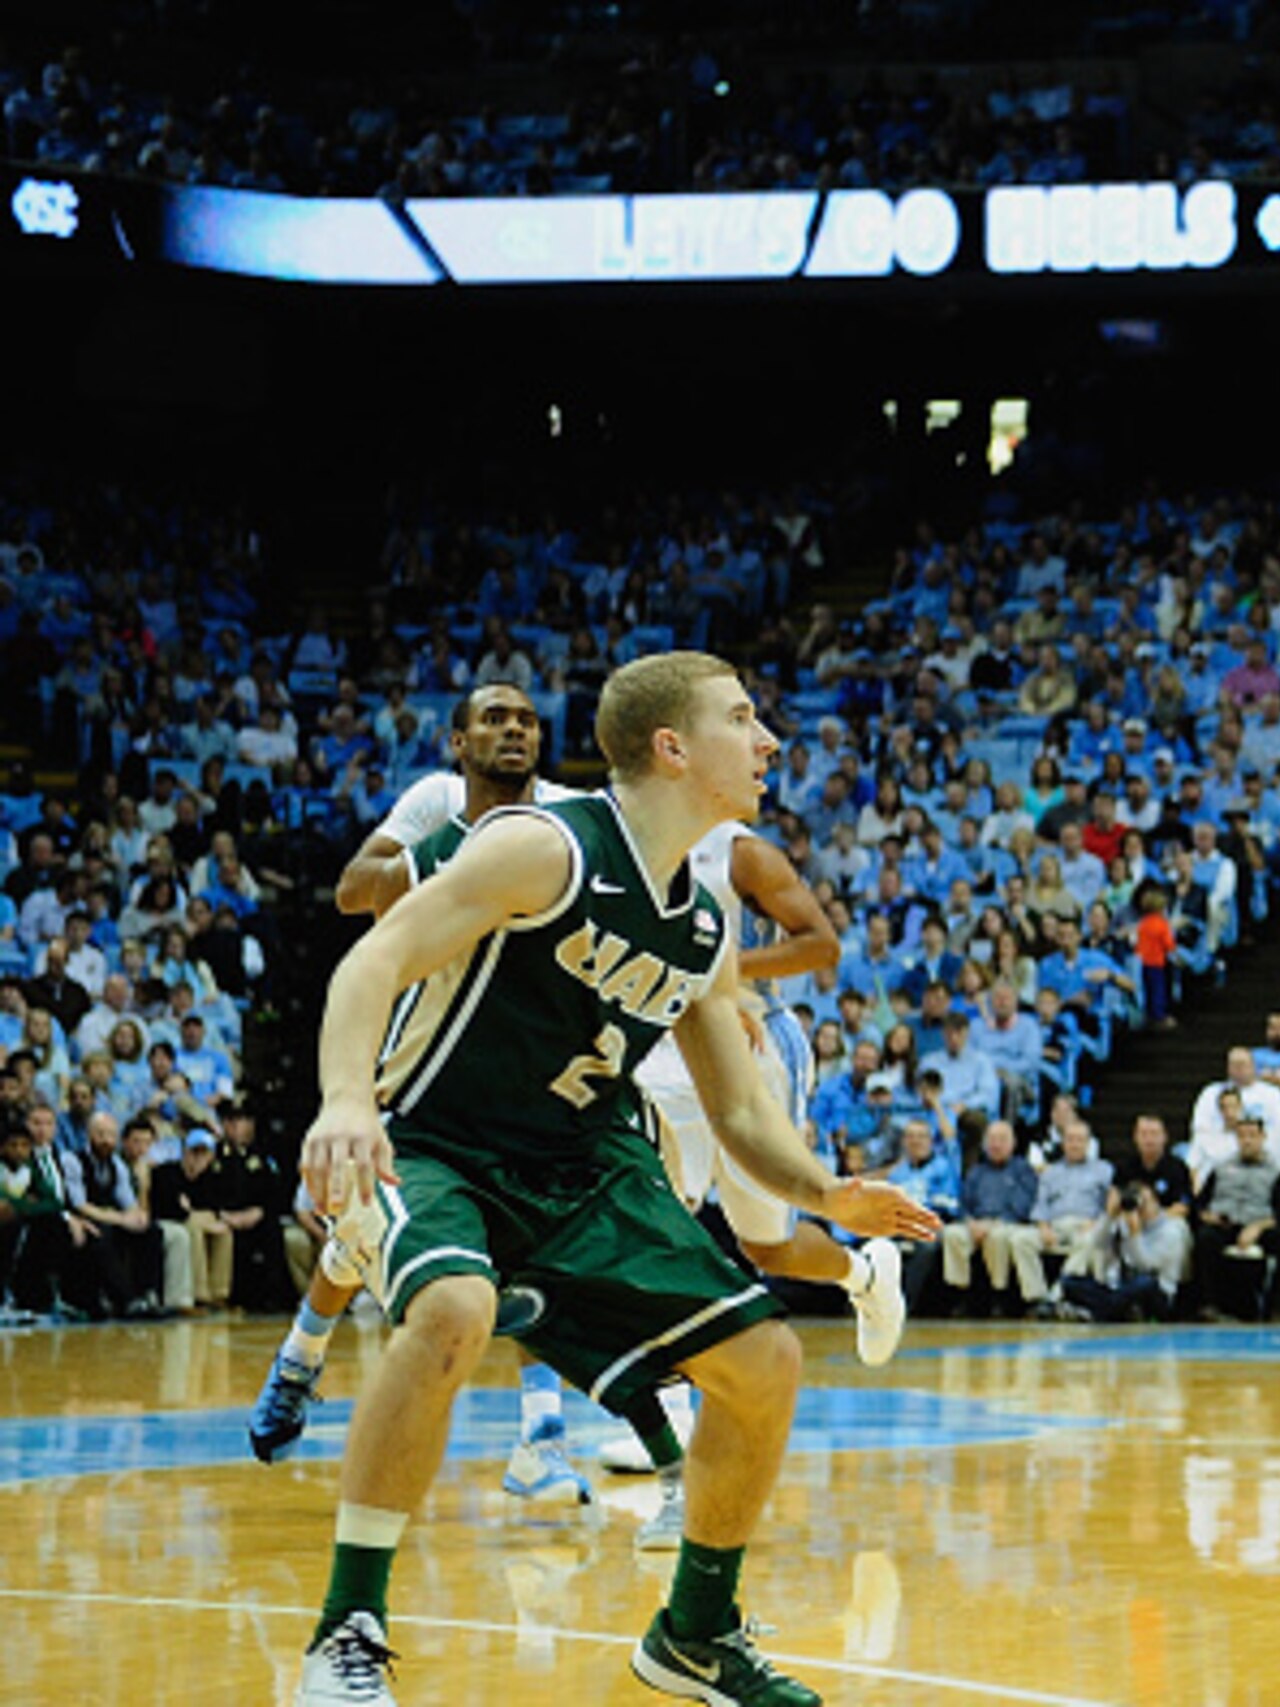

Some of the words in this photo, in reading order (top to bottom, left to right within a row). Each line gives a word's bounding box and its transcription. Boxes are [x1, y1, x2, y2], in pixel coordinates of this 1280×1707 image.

[597, 194, 805, 269] LET'S
[832, 190, 960, 275] GO
[985, 182, 1237, 272] HEELS
[548, 1022, 628, 1110] 2
